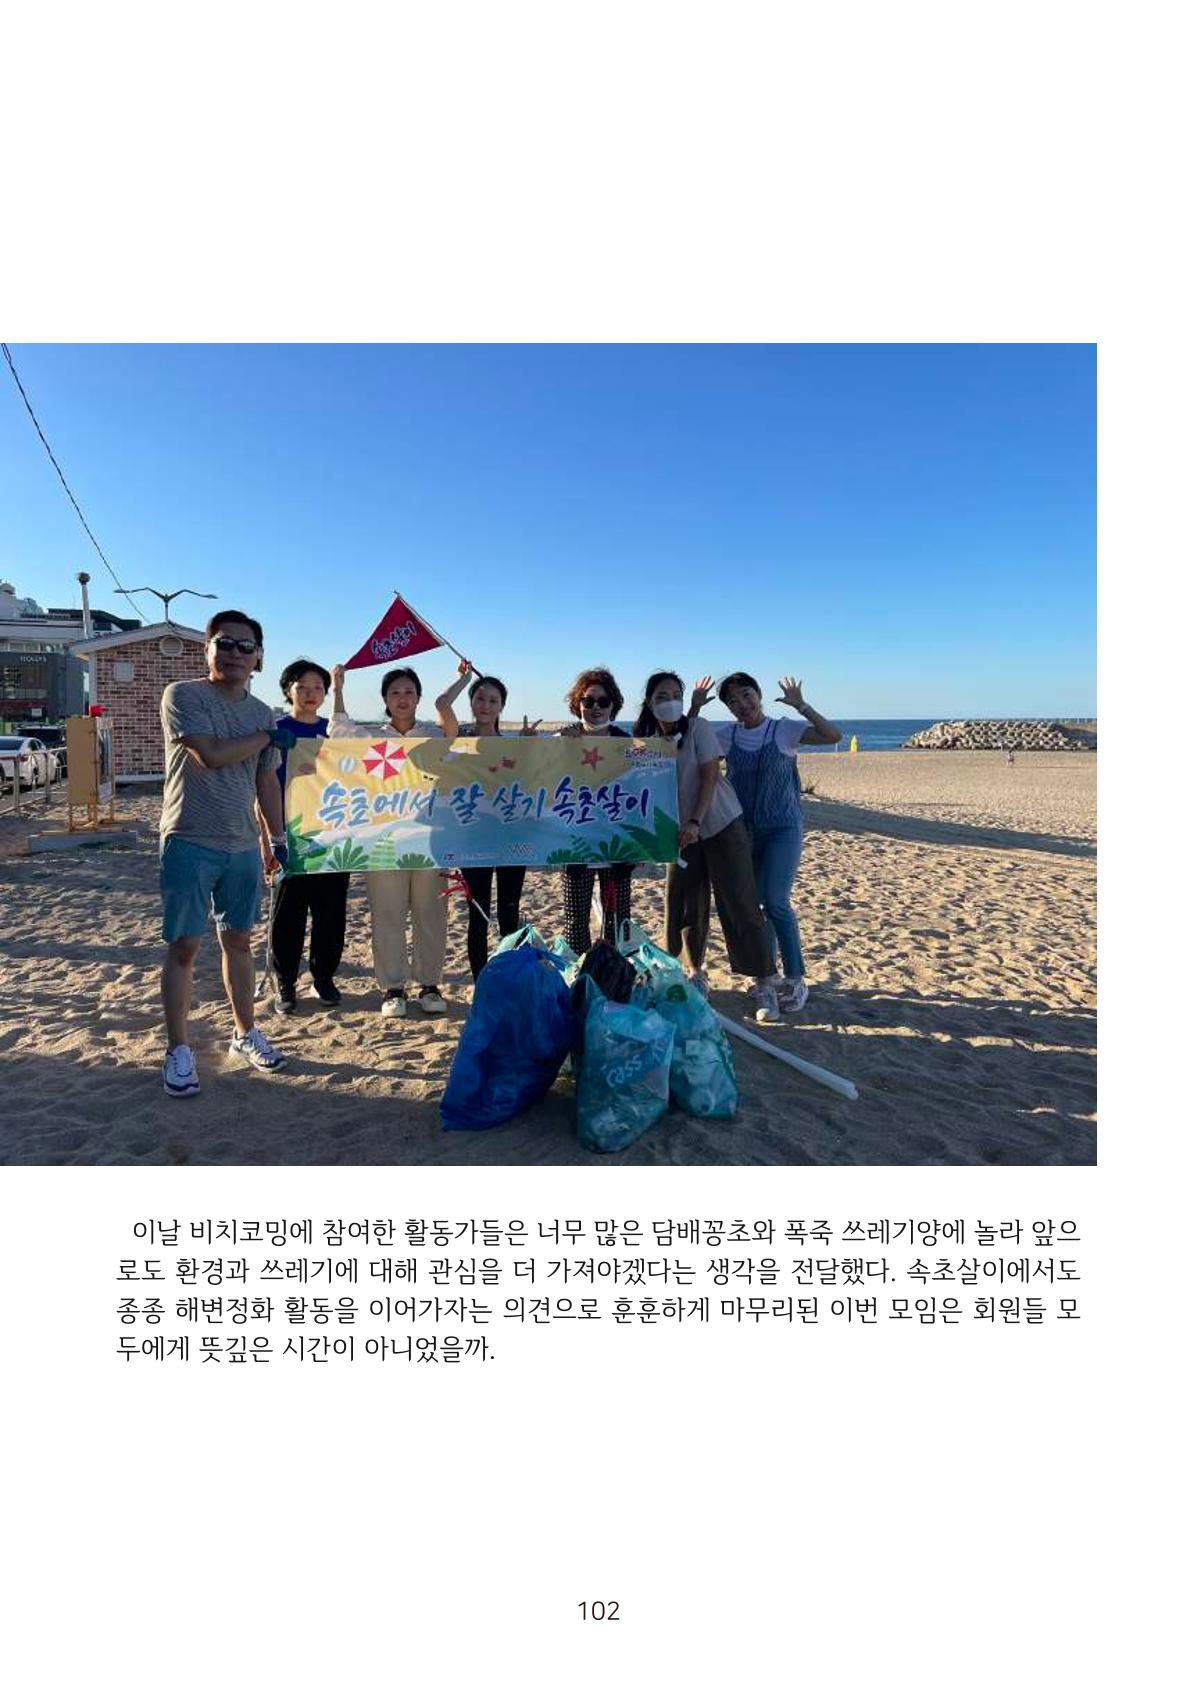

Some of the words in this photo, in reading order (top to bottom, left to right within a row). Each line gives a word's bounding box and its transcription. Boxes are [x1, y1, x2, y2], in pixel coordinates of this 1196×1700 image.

[318, 780, 437, 828] 속초에서
[450, 783, 484, 824] 잘
[492, 783, 546, 823] 살기
[552, 775, 649, 825] 속초살이
[134, 1219, 181, 1246] 이날
[190, 1219, 312, 1246] 비치코밍에
[323, 1219, 396, 1246] 참여한
[405, 1219, 528, 1246] 활동가들은
[538, 1219, 586, 1245] 너무
[595, 1219, 643, 1246] 많은
[652, 1219, 776, 1246] 담배꽁초와
[785, 1220, 833, 1245] 폭죽
[842, 1219, 964, 1246] 쓰레기양에
[974, 1219, 1023, 1246] 놀라
[1032, 1219, 1080, 1246] 앞으
[116, 1260, 165, 1280] 로도
[176, 1258, 249, 1285] 환경과
[260, 1258, 357, 1284] 쓰레기에
[369, 1258, 416, 1283] 대해
[429, 1258, 502, 1285] 관심을
[514, 1258, 534, 1284] 더
[547, 1258, 696, 1285] 가져야겠다는
[707, 1258, 780, 1285] 생각을
[792, 1258, 895, 1285] 전달했다.
[907, 1258, 1080, 1285] 속초살이에서도
[117, 1298, 165, 1324] 종종
[176, 1297, 274, 1324] 해변정화
[285, 1297, 358, 1324] 활동을
[370, 1297, 492, 1323] 이어가자는
[504, 1297, 601, 1323] 의견으로
[612, 1297, 709, 1323] 훈훈하게
[721, 1297, 818, 1323] 마무리된
[831, 1297, 877, 1323] 이번
[889, 1297, 962, 1324] 모임은
[974, 1297, 1046, 1324] 회원들
[1057, 1299, 1080, 1319] 모
[117, 1336, 188, 1362] 두에게
[200, 1336, 273, 1362] 뜻깊은
[283, 1336, 353, 1362] 시간이
[365, 1336, 494, 1362] 아니었을까.
[578, 1601, 620, 1621] 102
